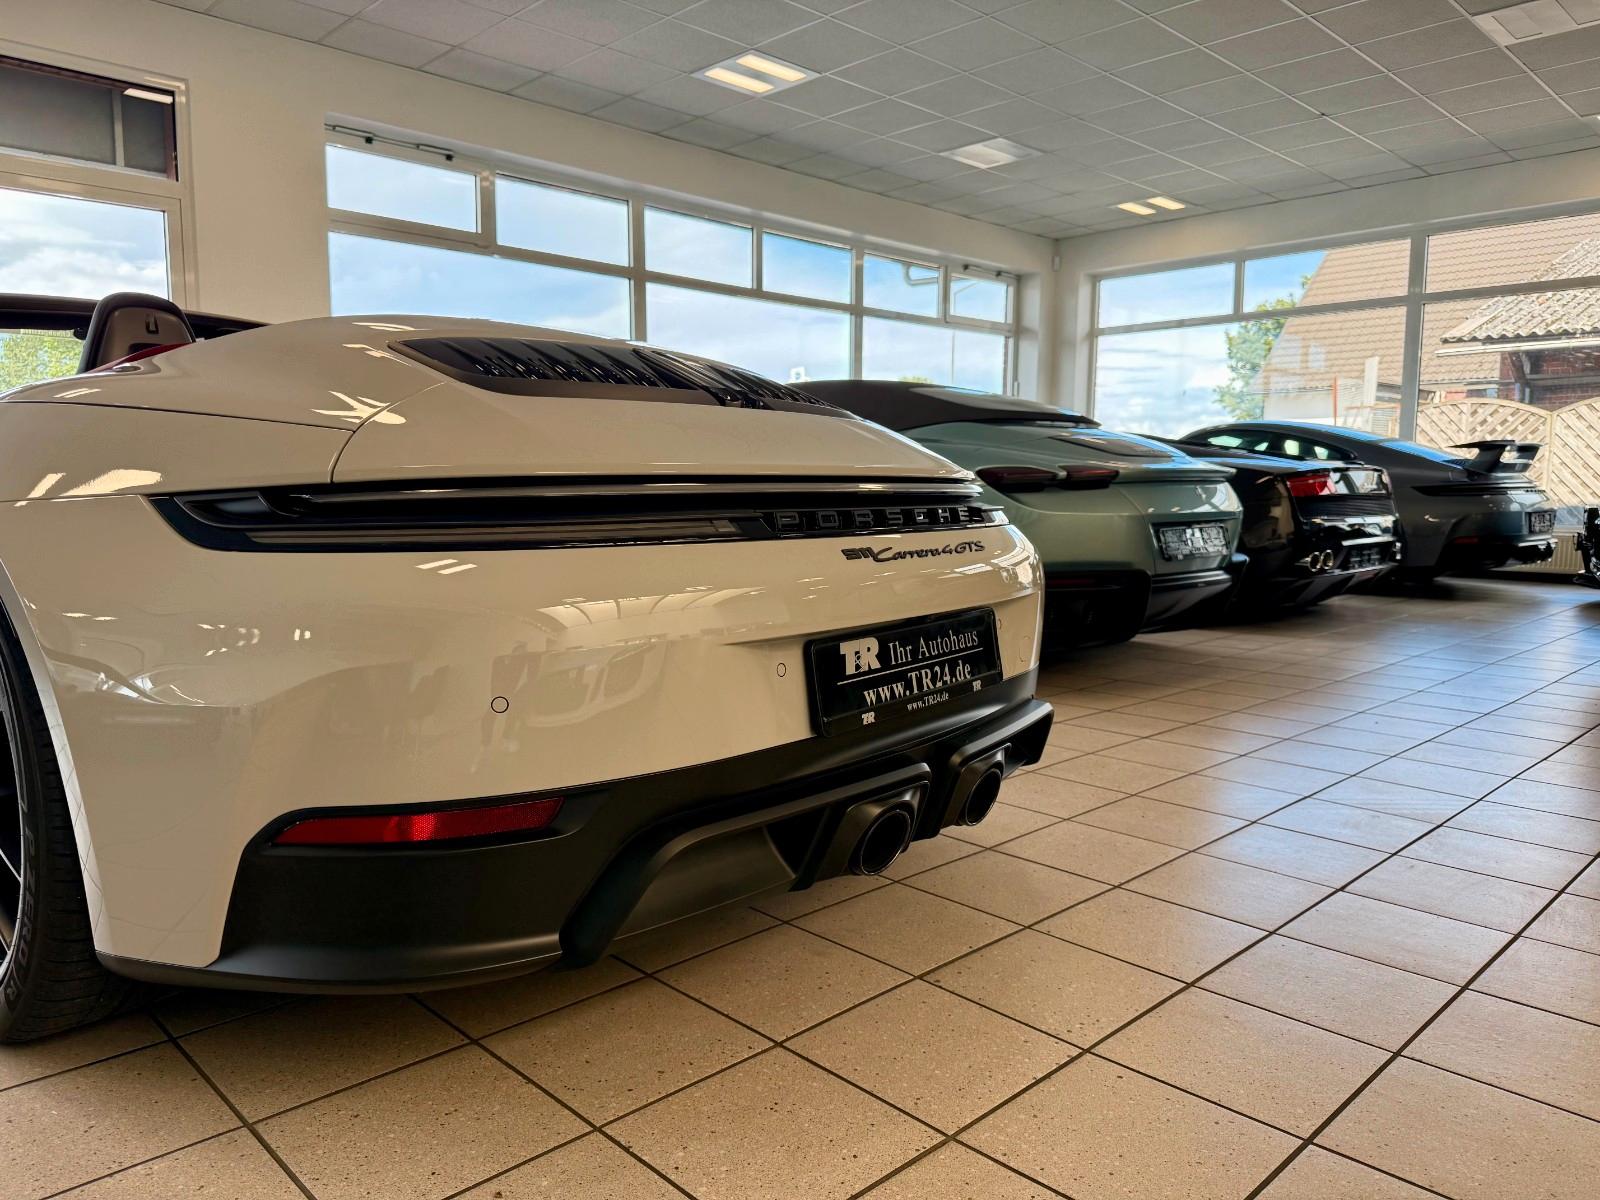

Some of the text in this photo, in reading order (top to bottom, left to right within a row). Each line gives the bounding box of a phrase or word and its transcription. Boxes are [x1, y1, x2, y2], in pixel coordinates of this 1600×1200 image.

[774, 506, 970, 529] PORSCHE
[873, 547, 941, 562] Carrera
[954, 540, 986, 554] GTS
[888, 641, 912, 665] Ihr
[918, 630, 979, 659] Autohaus
[863, 659, 972, 708] www.TR24.de
[906, 690, 949, 711] www.TR24.de
